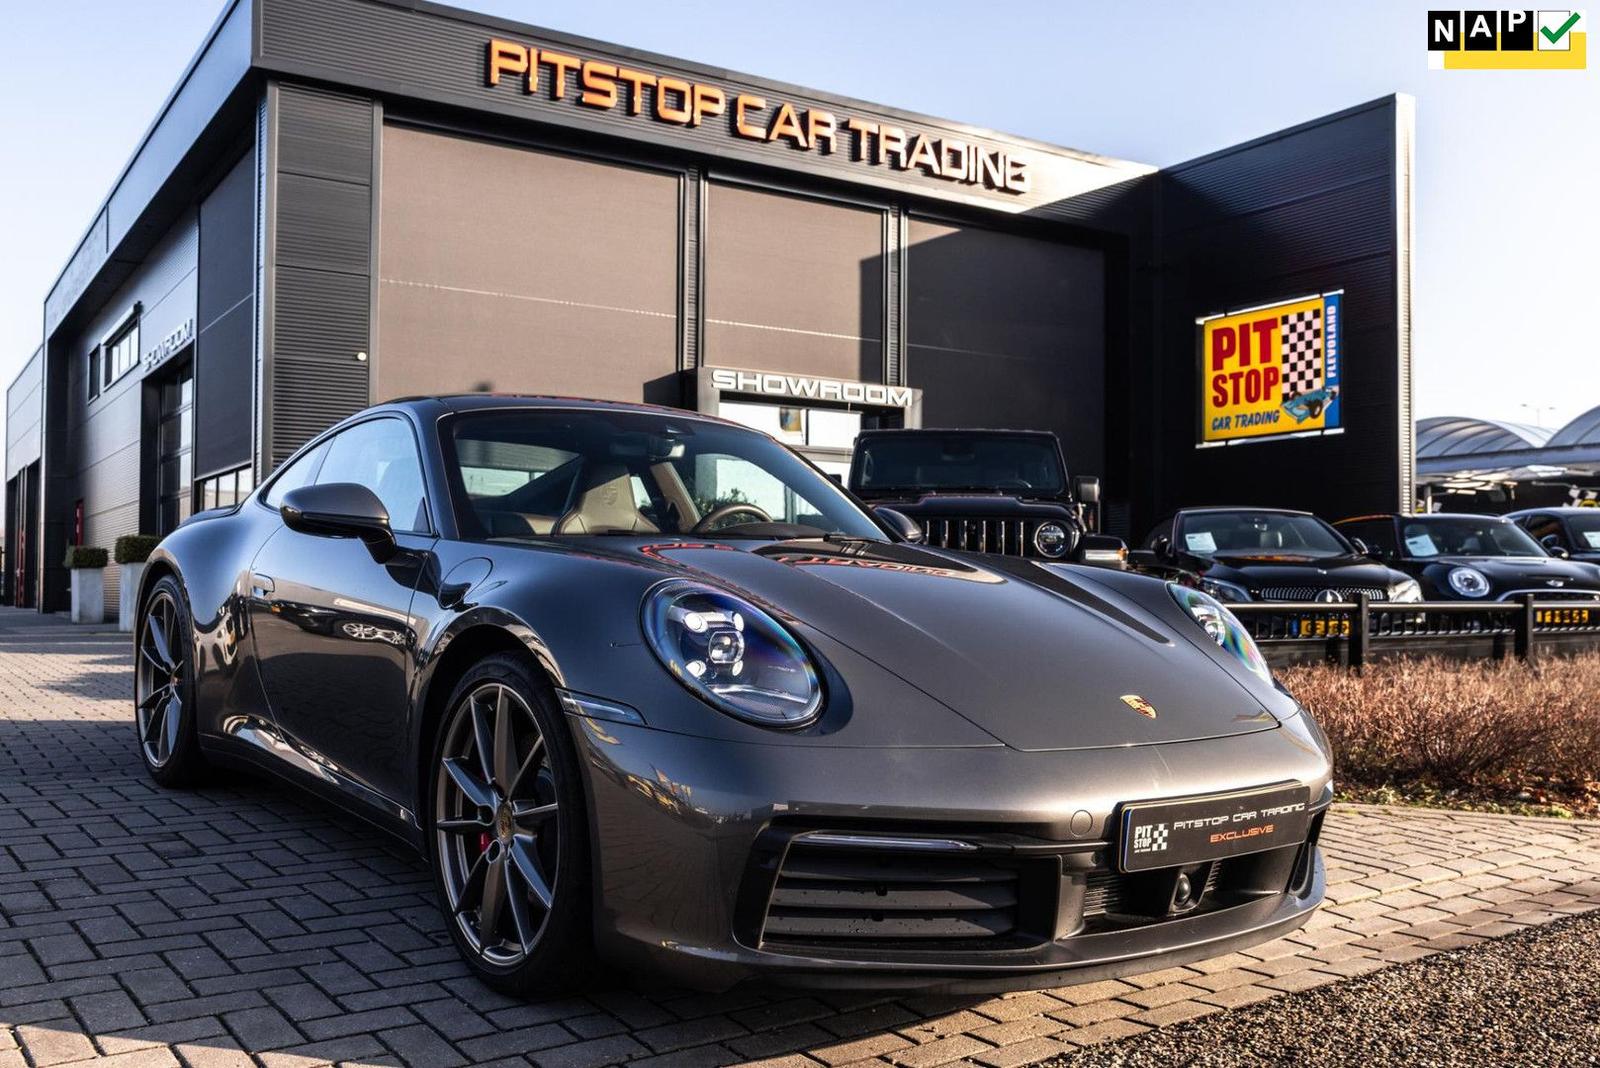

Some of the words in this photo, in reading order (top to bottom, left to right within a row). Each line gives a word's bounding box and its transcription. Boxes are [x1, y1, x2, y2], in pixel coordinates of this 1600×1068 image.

[489, 38, 726, 128] PITSTOP
[736, 94, 838, 155] CAR
[847, 117, 1032, 194] TRADING
[1211, 317, 1279, 372] PIT
[1326, 305, 1337, 379] FLEVOLAND
[712, 369, 913, 407] SHOWROOM
[1212, 366, 1280, 408] STOP
[1212, 415, 1232, 431] CAR
[1234, 409, 1281, 429] TRADING
[1134, 824, 1154, 839] PIT
[1173, 815, 1230, 831] PITSTOP
[1232, 811, 1258, 823] CAR
[1260, 802, 1306, 818] TRADING
[1133, 837, 1153, 849] STOP
[1209, 824, 1275, 843] EXCLUSIVE
